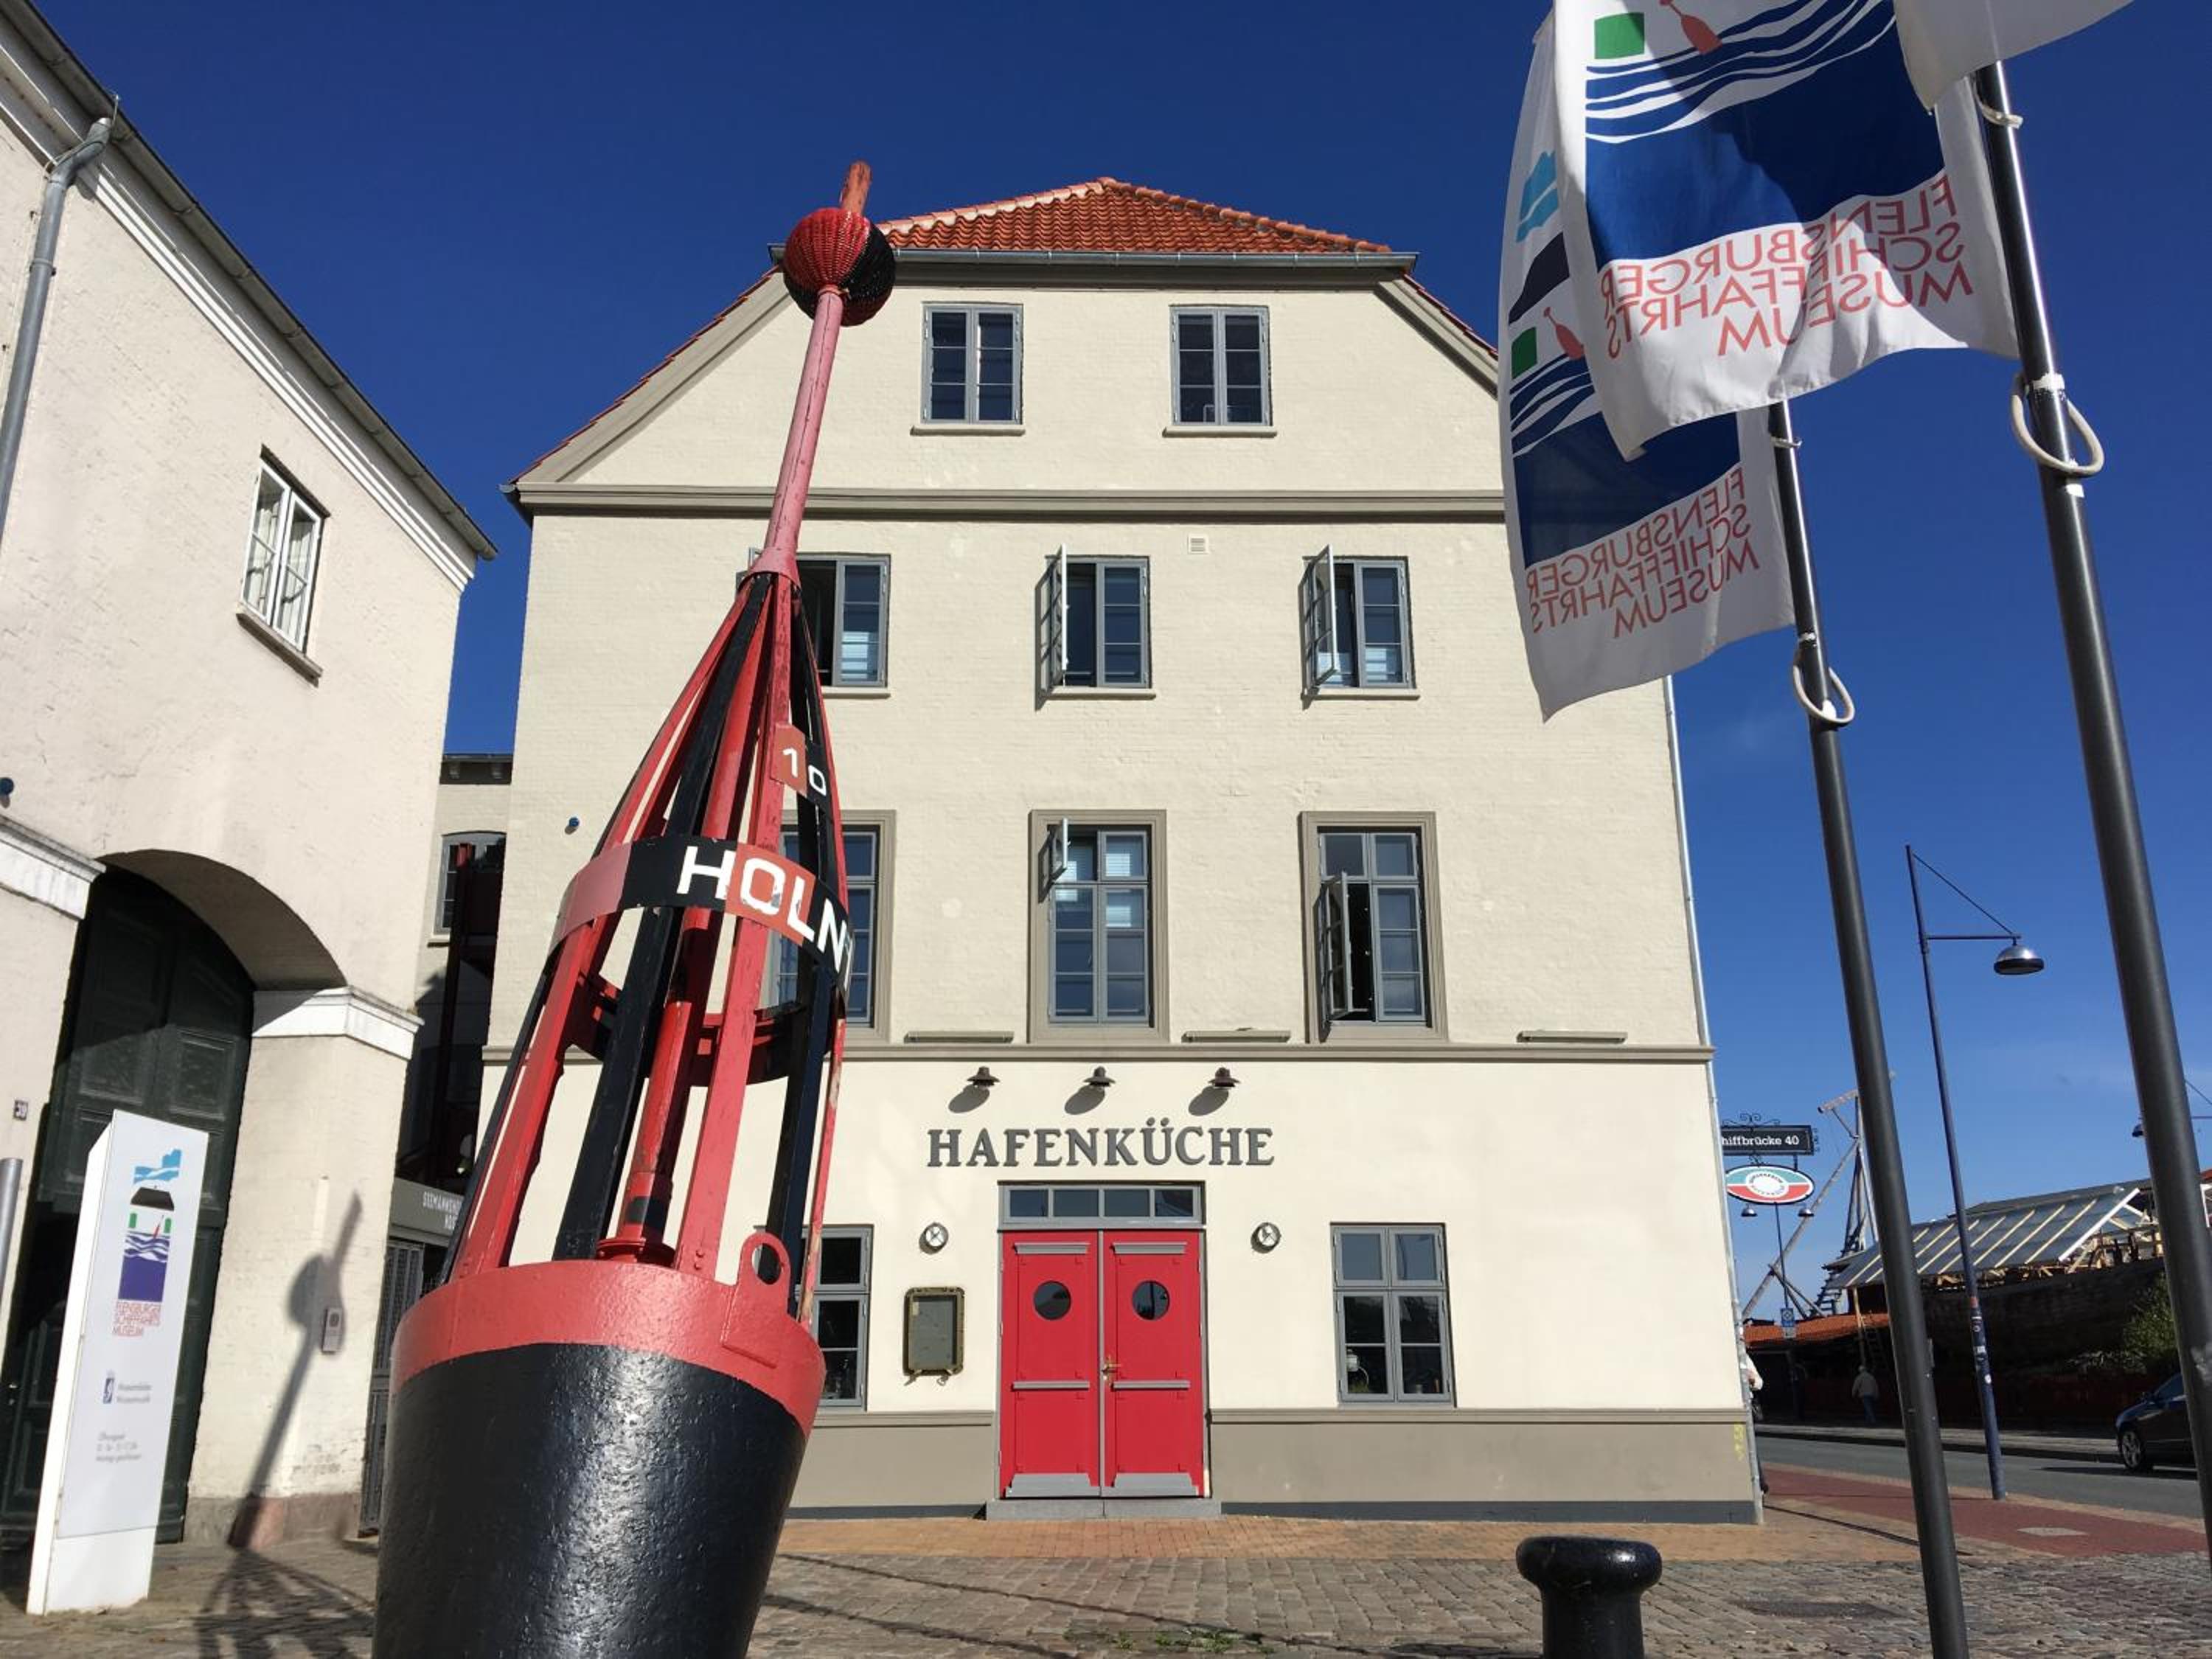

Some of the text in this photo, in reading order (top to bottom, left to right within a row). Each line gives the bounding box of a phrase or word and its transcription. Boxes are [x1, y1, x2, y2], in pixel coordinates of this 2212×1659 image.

[927, 1116, 1274, 1167] HAFENKÜCHE
[1722, 1135, 1800, 1145] hiffbrücke 40
